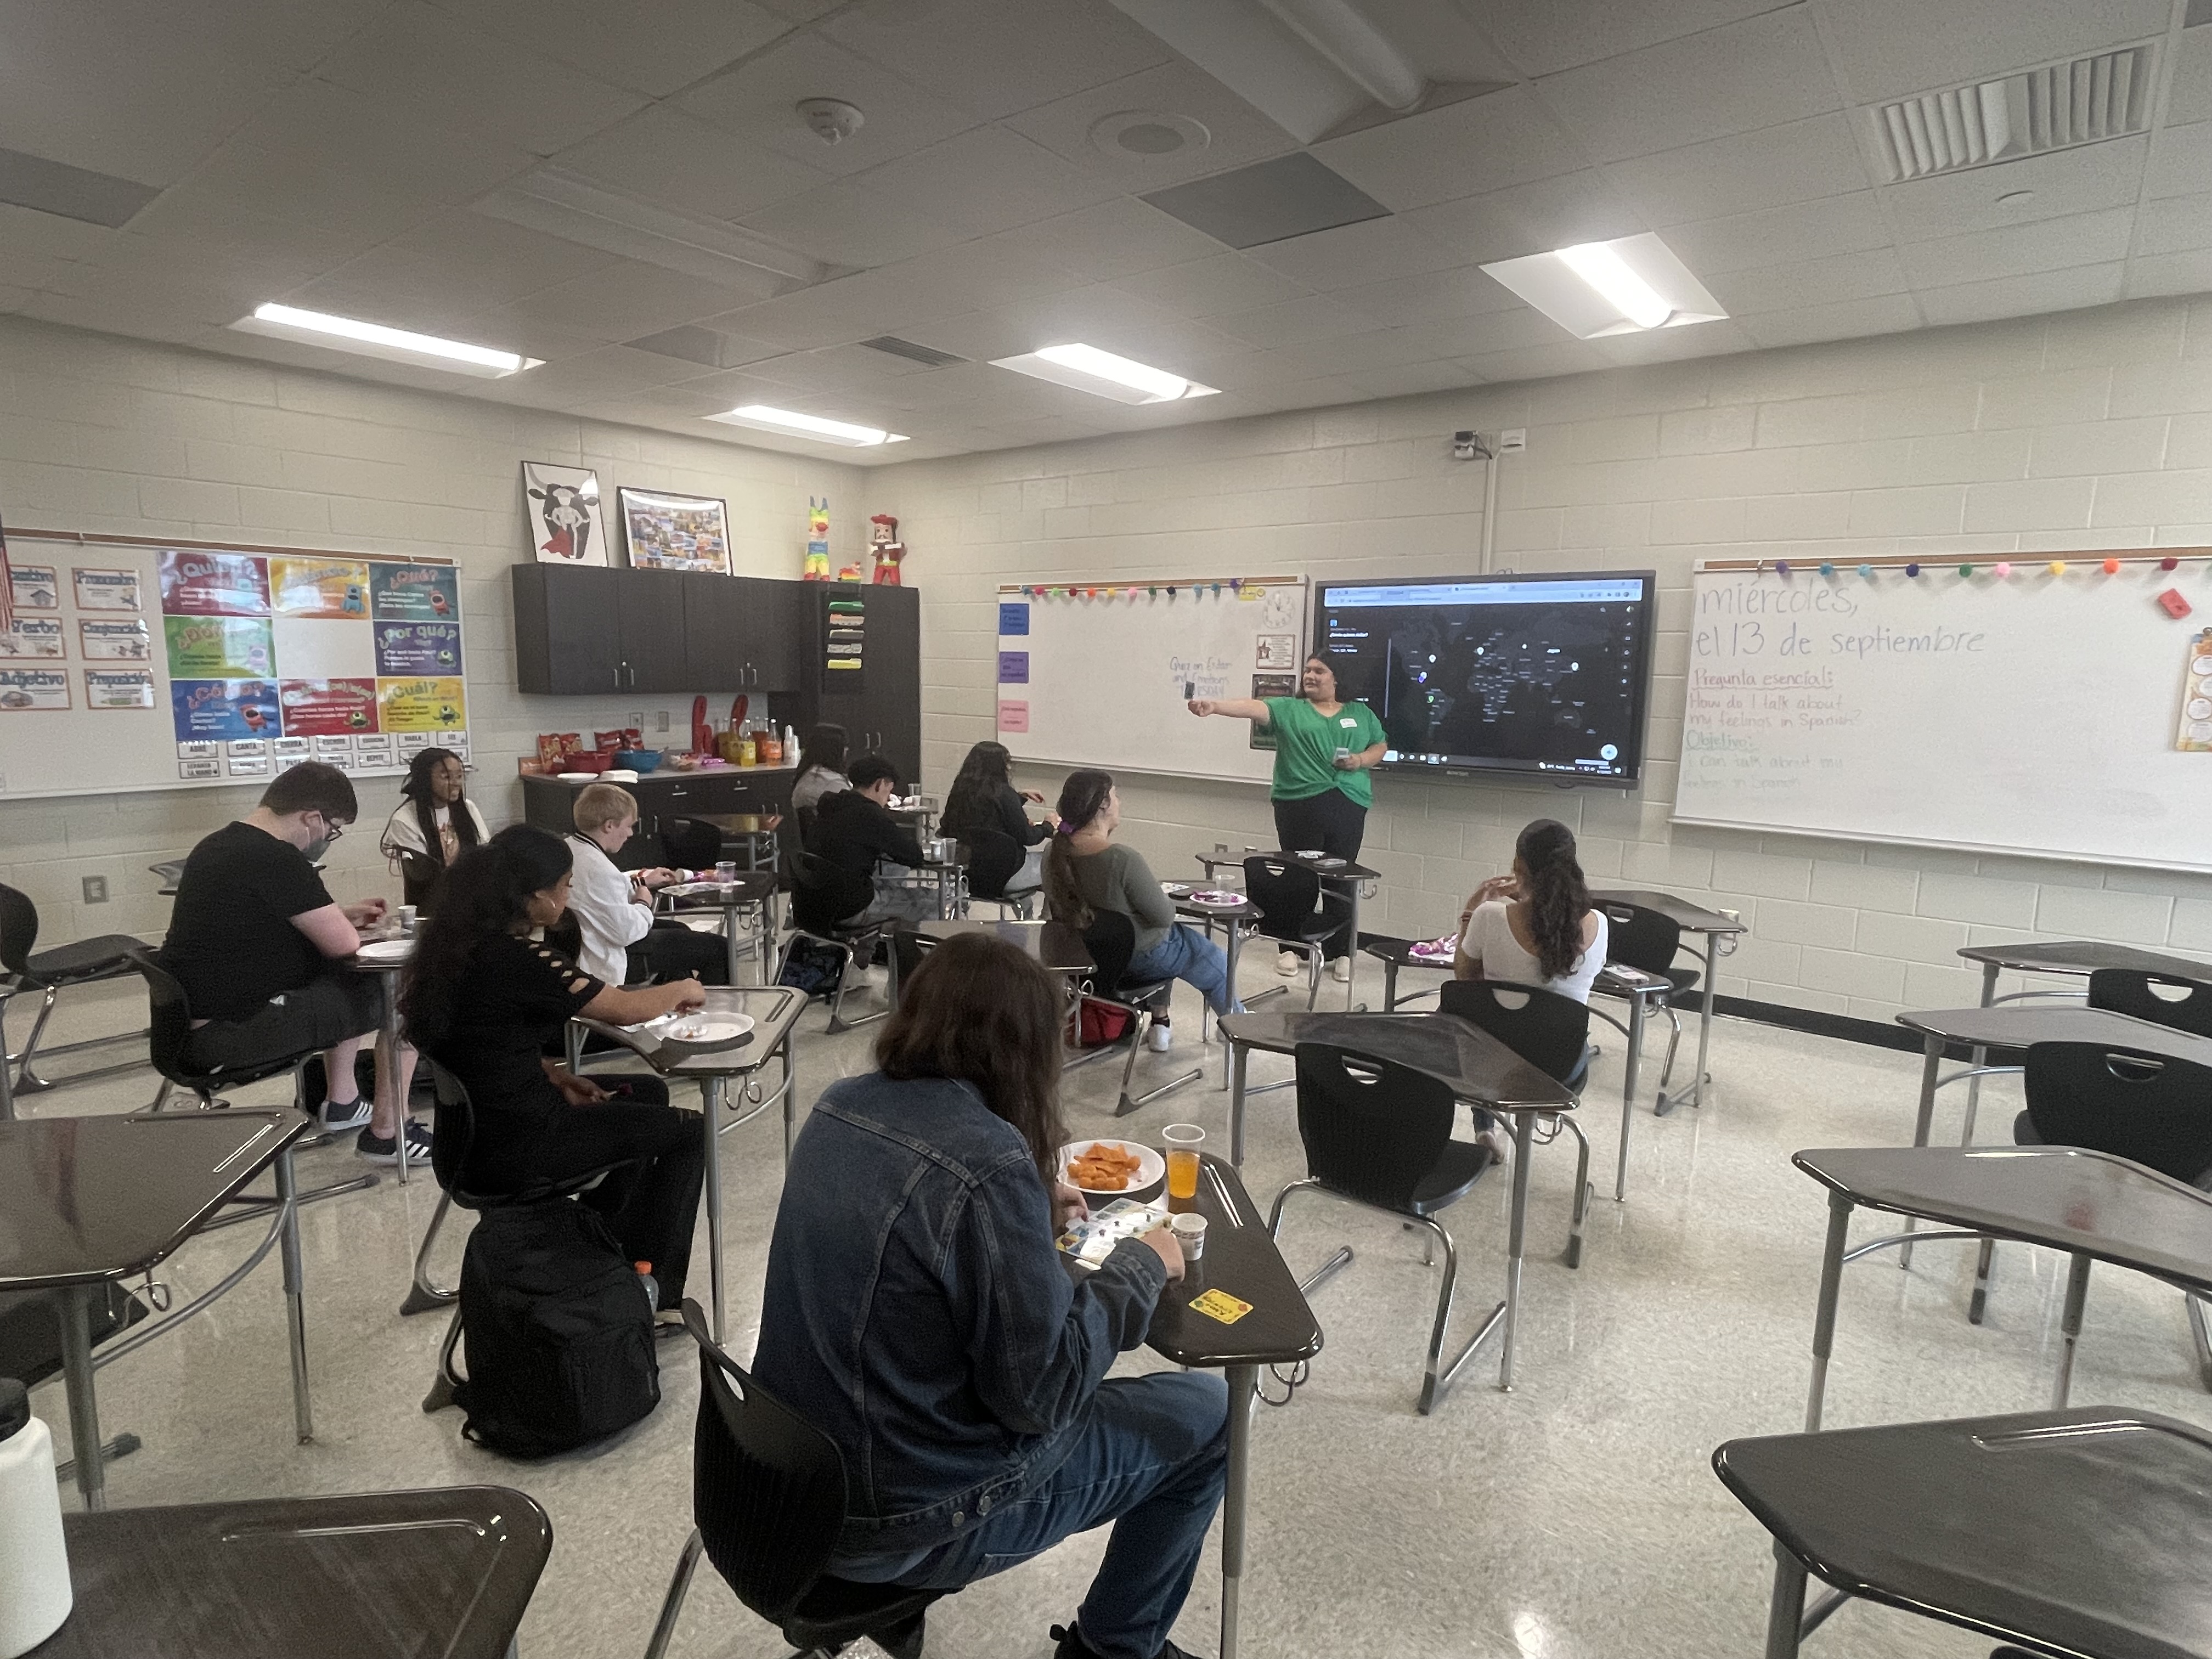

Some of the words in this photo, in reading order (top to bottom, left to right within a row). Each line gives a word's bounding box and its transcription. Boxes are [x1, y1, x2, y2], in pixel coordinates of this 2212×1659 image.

[1702, 577, 1859, 618] miércoles,
[1695, 626, 1719, 657] el
[1732, 620, 1765, 657] 13
[1780, 621, 1812, 656] de
[1830, 624, 1985, 660] septiembre
[1694, 667, 1757, 689] Pregunta
[1689, 690, 1722, 709] How
[1726, 695, 1743, 709] do
[1763, 693, 1789, 710] talk
[1796, 693, 1843, 709] about
